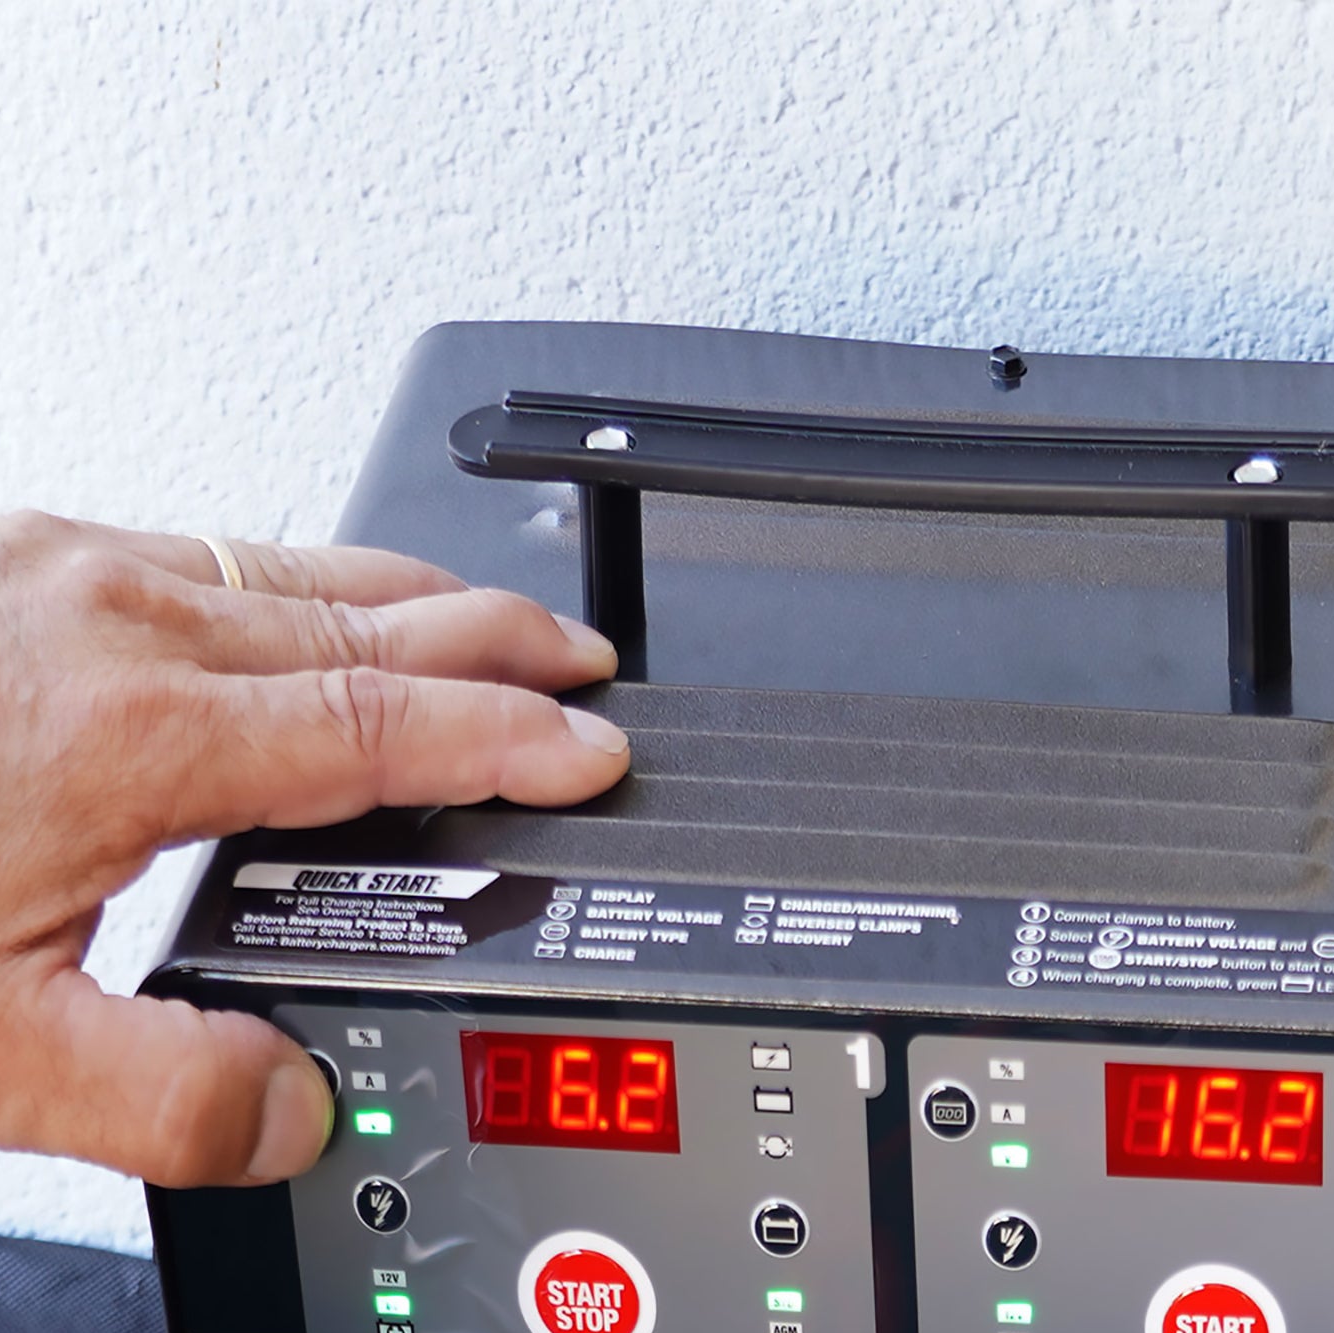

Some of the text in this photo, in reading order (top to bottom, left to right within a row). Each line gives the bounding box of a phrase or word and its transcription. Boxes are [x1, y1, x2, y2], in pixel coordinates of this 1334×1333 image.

[293, 870, 366, 892] QUICK
[275, 895, 444, 913] For Full Charging Instructions
[591, 888, 655, 904] DISPLAY
[297, 905, 417, 920] See Owner's Manual
[586, 906, 724, 925] BATTERY VOLTAGE
[781, 899, 957, 919] CHARGED/MAINTAINING
[243, 913, 463, 934] Before Returning Product To Store
[776, 915, 922, 934] REVERSED CLAMPS
[1054, 910, 1110, 925] Connect
[1114, 912, 1163, 928] clamps
[1167, 916, 1181, 927] to
[1185, 916, 1237, 931] battery.
[232, 923, 255, 933] Call
[258, 924, 315, 937] Customer
[319, 927, 364, 939] Service
[580, 925, 689, 944] BATTERY TYPE
[772, 930, 853, 947] RECOVERY
[1049, 930, 1093, 944] Select
[1137, 932, 1205, 949] BATTERY
[1208, 935, 1276, 951] VOLTAGE
[1280, 941, 1307, 952] and
[234, 934, 456, 956] Patent: Batterychargers.com/patents
[574, 946, 637, 962] CHARGE
[1046, 951, 1084, 963] Press
[1124, 954, 1218, 969] START/STOP
[1221, 958, 1266, 971] button
[1270, 960, 1284, 972] to
[1287, 960, 1319, 973] start
[1043, 970, 1081, 984] When
[1085, 972, 1145, 987] charging
[1149, 973, 1161, 986] is
[1165, 975, 1233, 990] complete,
[1237, 980, 1276, 991] green
[845, 1037, 871, 1089] 1
[365, 1075, 374, 1087] A
[551, 1046, 667, 1132] 6.2
[1003, 1109, 1012, 1121] A
[1161, 1075, 1316, 1161] 16.2
[380, 1272, 399, 1284] 12V
[548, 1281, 624, 1308] START
[556, 1306, 619, 1332] STOP
